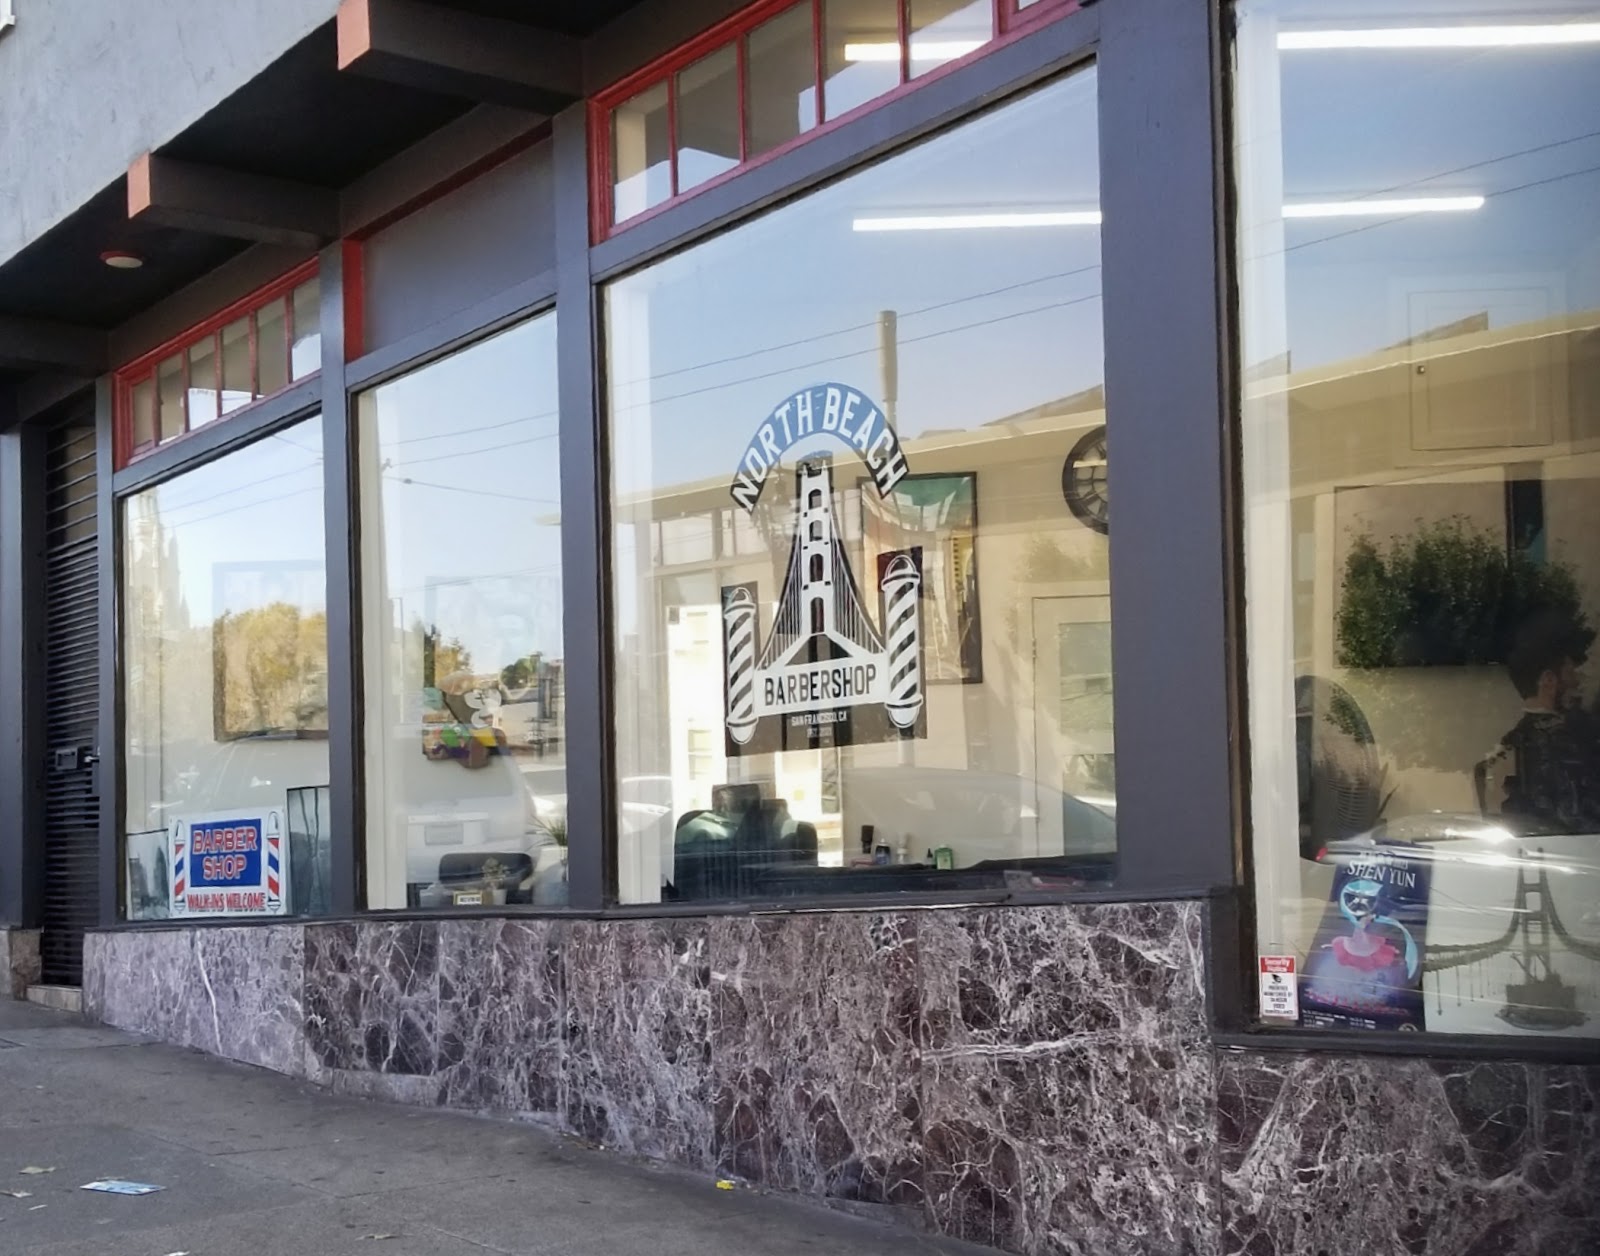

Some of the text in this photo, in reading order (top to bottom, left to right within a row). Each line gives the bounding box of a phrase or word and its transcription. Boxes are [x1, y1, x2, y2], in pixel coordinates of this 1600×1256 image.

[732, 386, 907, 511] NORTH BEACH
[764, 663, 877, 707] BARBERSHOP
[192, 826, 258, 854] BARBER
[203, 854, 247, 880] SHOP
[1347, 859, 1416, 889] SHEN YUN
[187, 892, 267, 912] WALK-INS WELCOME
